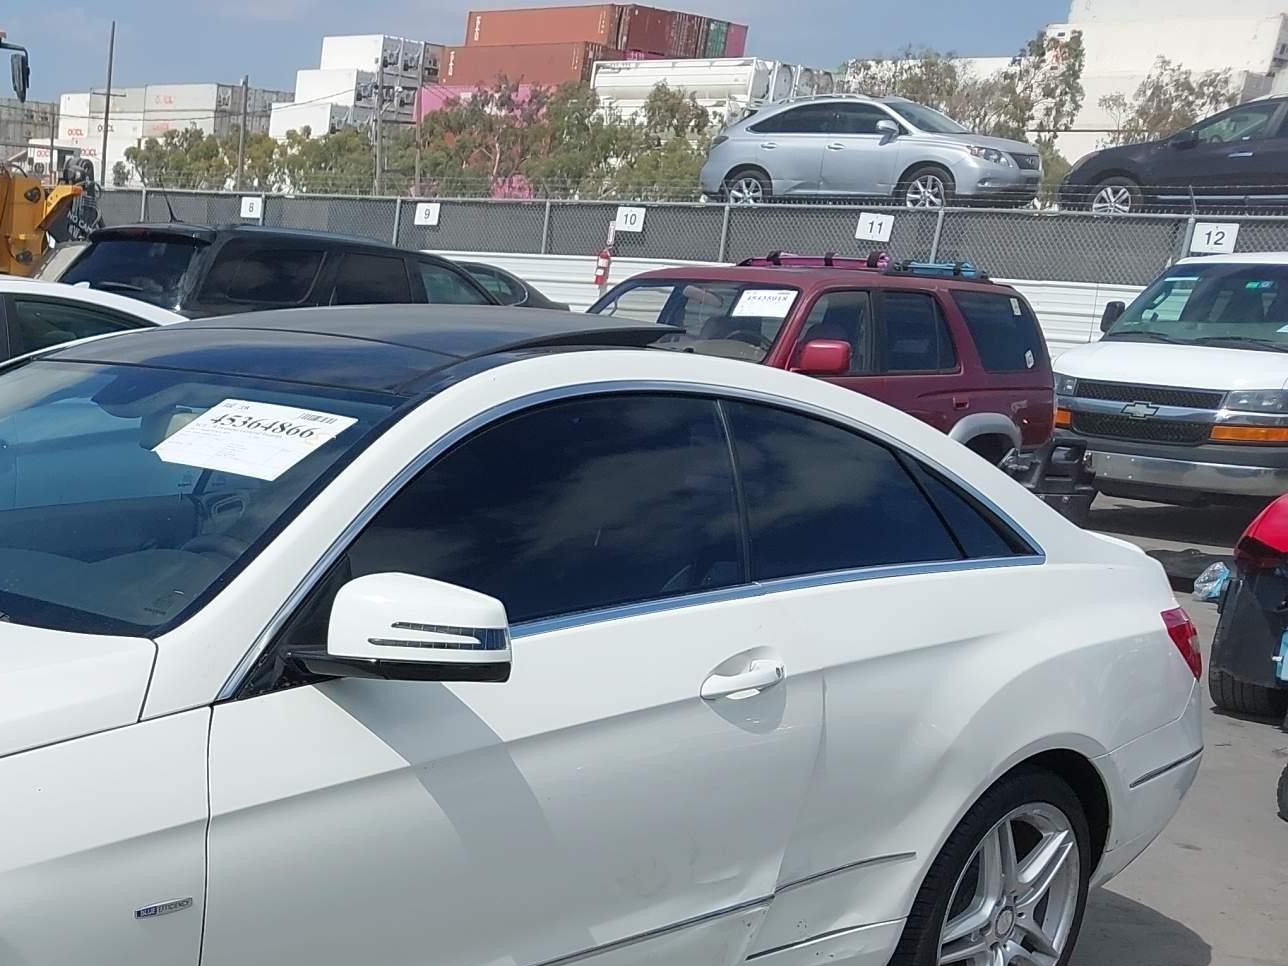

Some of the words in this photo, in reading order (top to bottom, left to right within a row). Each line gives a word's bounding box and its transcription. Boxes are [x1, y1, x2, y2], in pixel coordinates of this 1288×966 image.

[423, 208, 431, 219] 9
[623, 213, 637, 225] 10
[867, 219, 885, 234] 11
[1205, 230, 1225, 245] 12
[210, 412, 318, 439] 45364866
